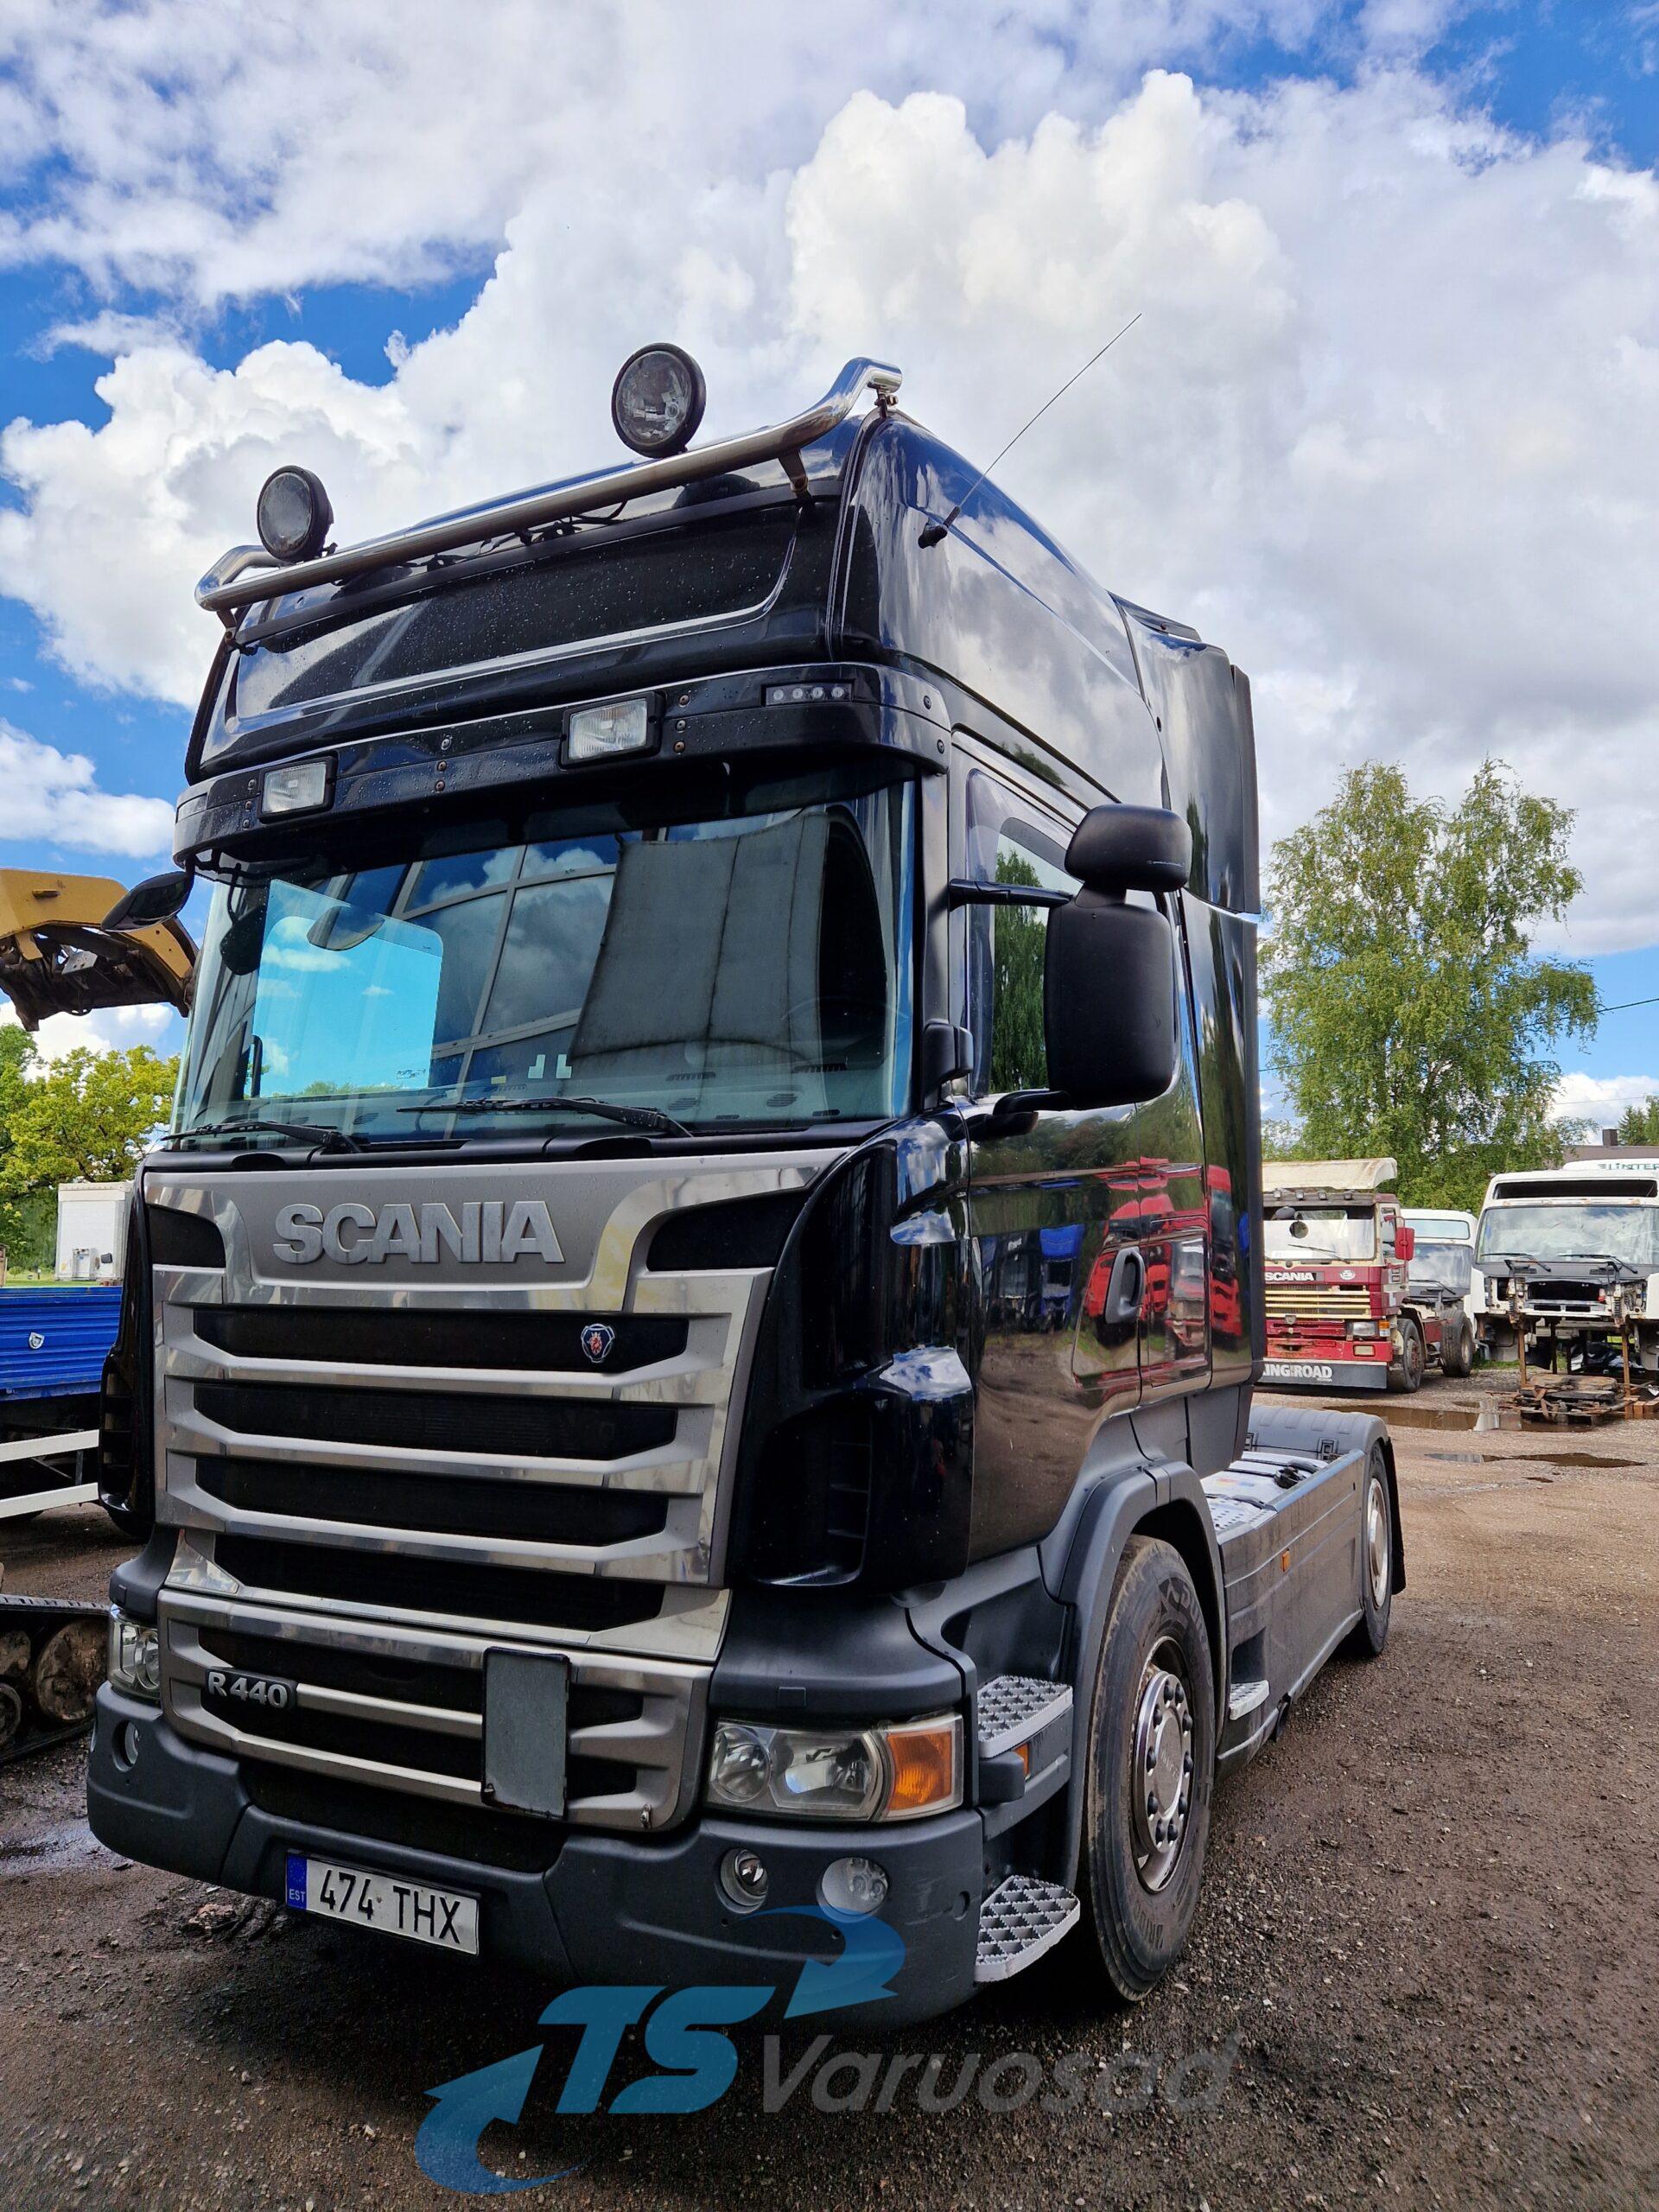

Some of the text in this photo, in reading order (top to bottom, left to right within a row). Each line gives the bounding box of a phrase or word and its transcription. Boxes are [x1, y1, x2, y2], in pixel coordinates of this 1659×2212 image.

[273, 1200, 566, 1265] SCANIA
[1265, 1271, 1315, 1281] SCANIA
[1294, 1364, 1333, 1379] ROAD
[289, 1869, 461, 1944] EST 474 THX
